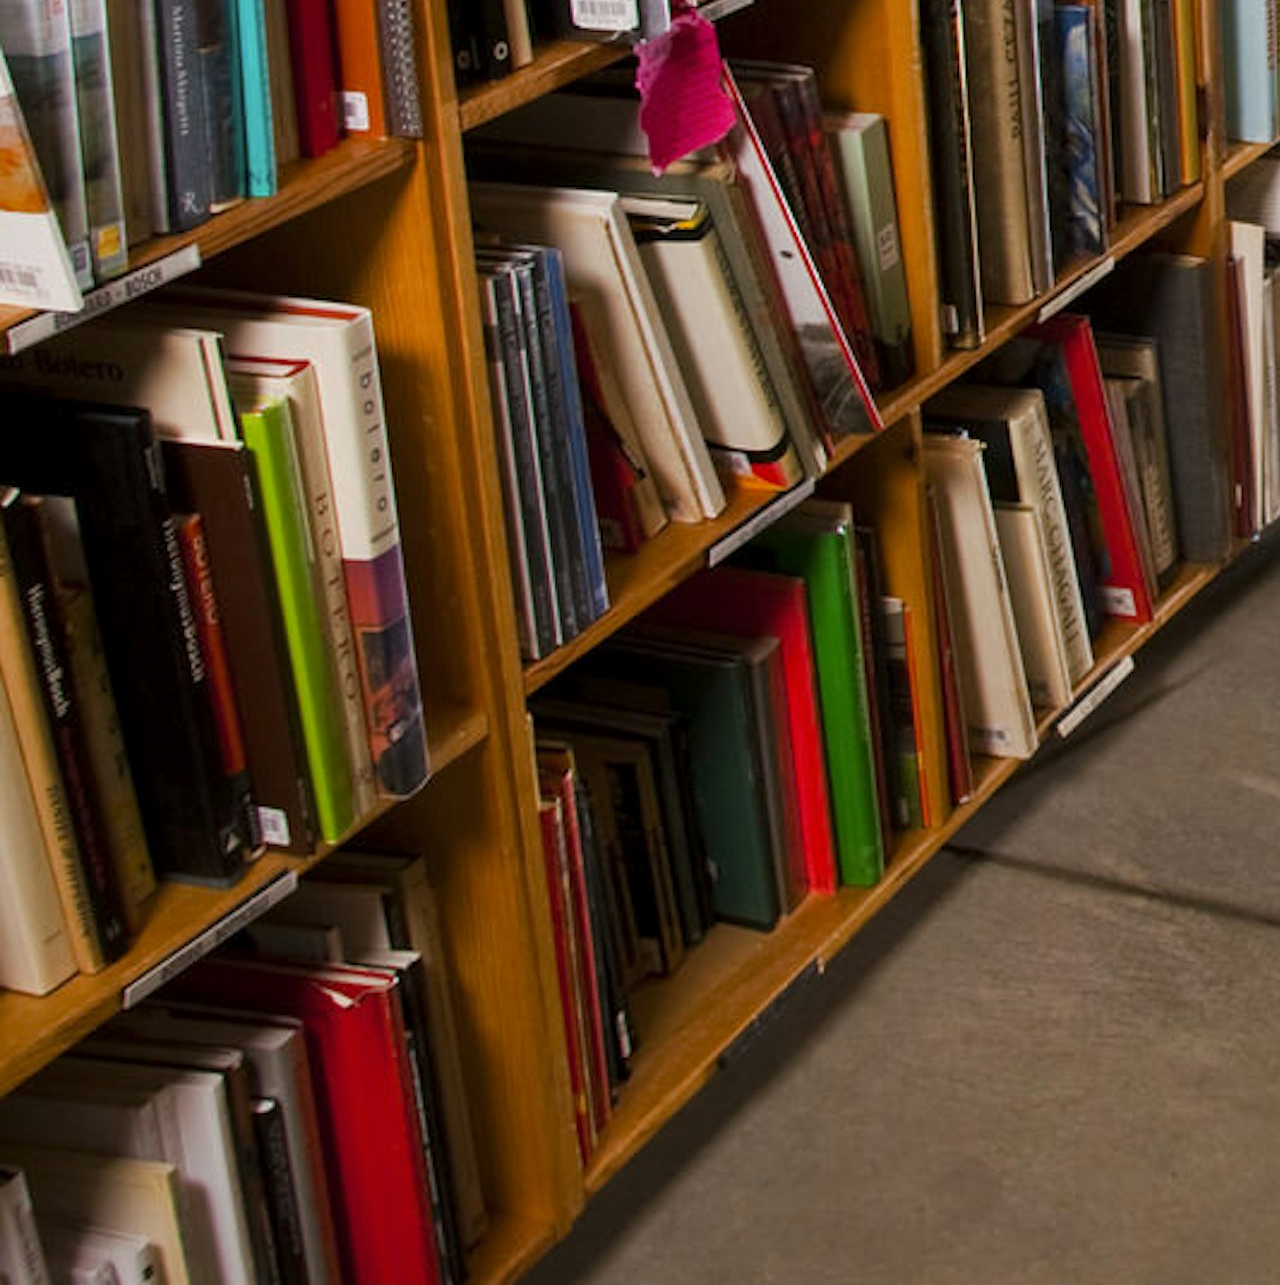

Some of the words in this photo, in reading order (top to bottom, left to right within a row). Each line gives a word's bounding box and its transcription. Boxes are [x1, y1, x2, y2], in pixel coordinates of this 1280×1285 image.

[315, 494, 357, 702] BOTERO
[1036, 439, 1058, 519] MARC
[1052, 522, 1080, 643] CHAGALL
